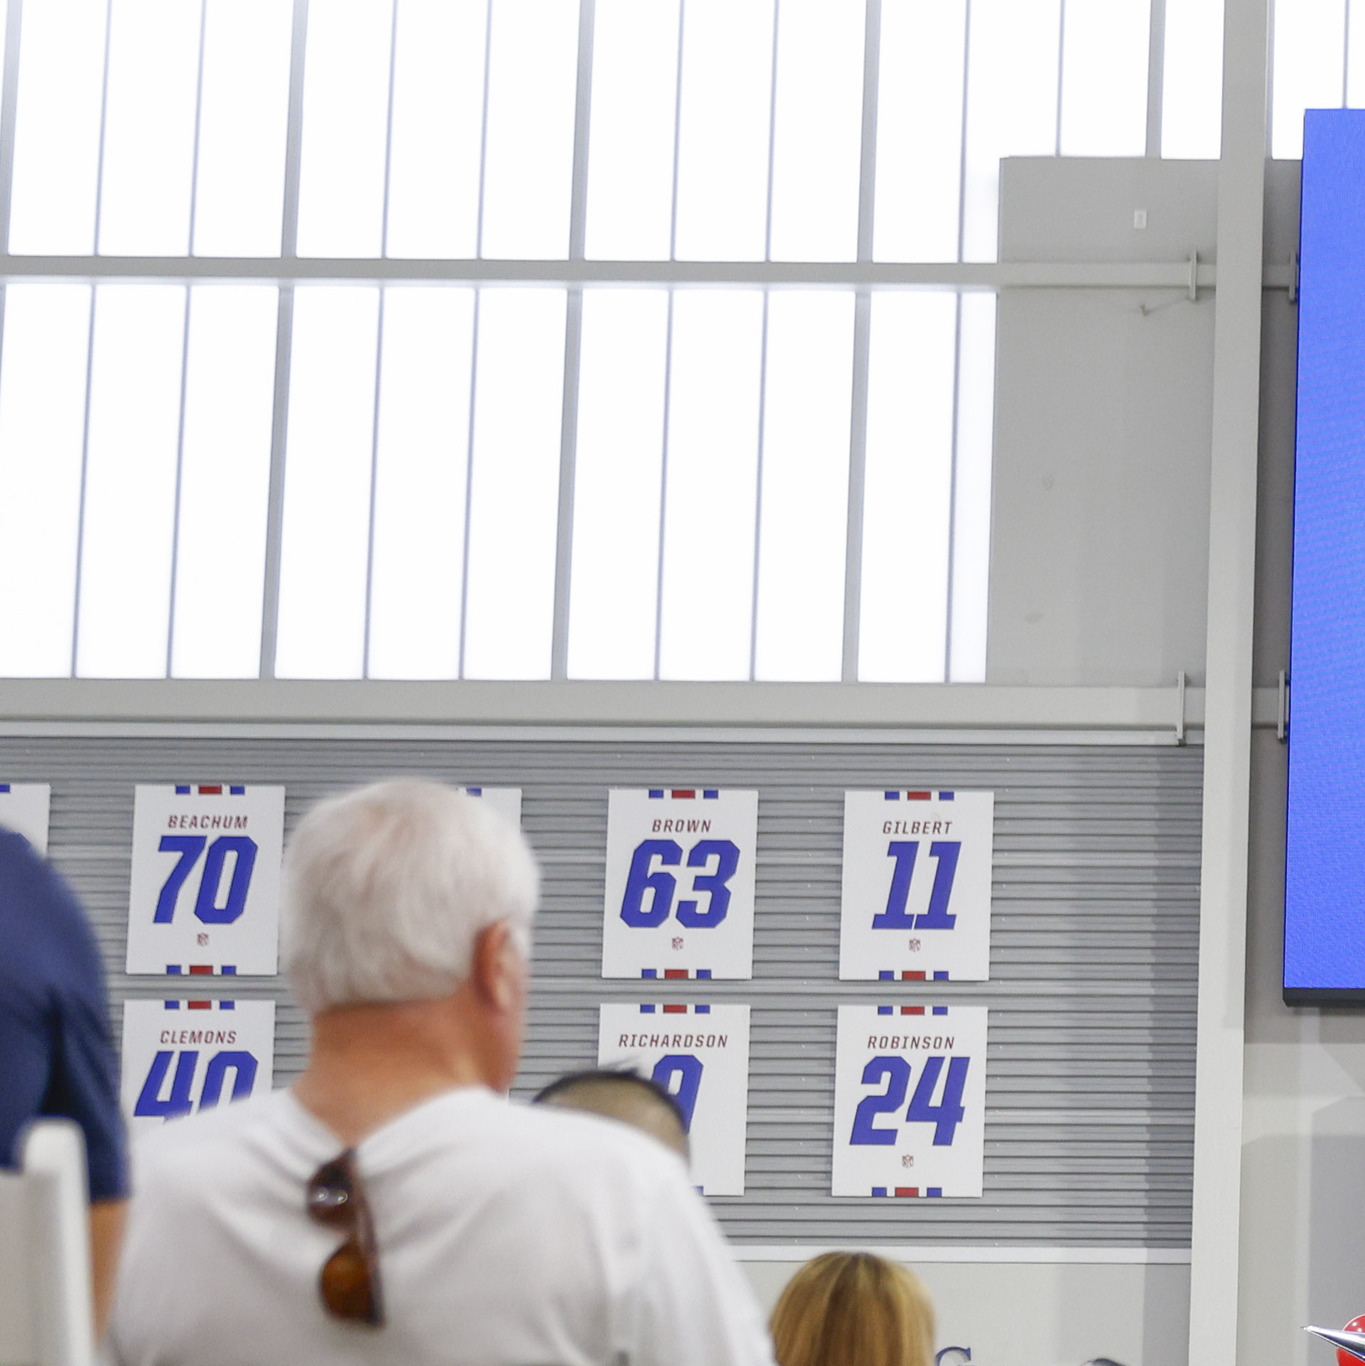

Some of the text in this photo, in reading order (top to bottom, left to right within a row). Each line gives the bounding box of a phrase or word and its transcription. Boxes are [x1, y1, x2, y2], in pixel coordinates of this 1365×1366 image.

[167, 814, 249, 830] BEACHUM
[651, 818, 713, 834] BROWN
[882, 820, 954, 836] GILBERT
[153, 835, 258, 925] 70
[619, 838, 741, 929] 63
[871, 841, 962, 930] 11
[160, 1030, 237, 1045] CLEMONS
[618, 1033, 729, 1049] RICHARDSON
[866, 1034, 956, 1050] ROBINSON
[849, 1055, 970, 1147] 24
